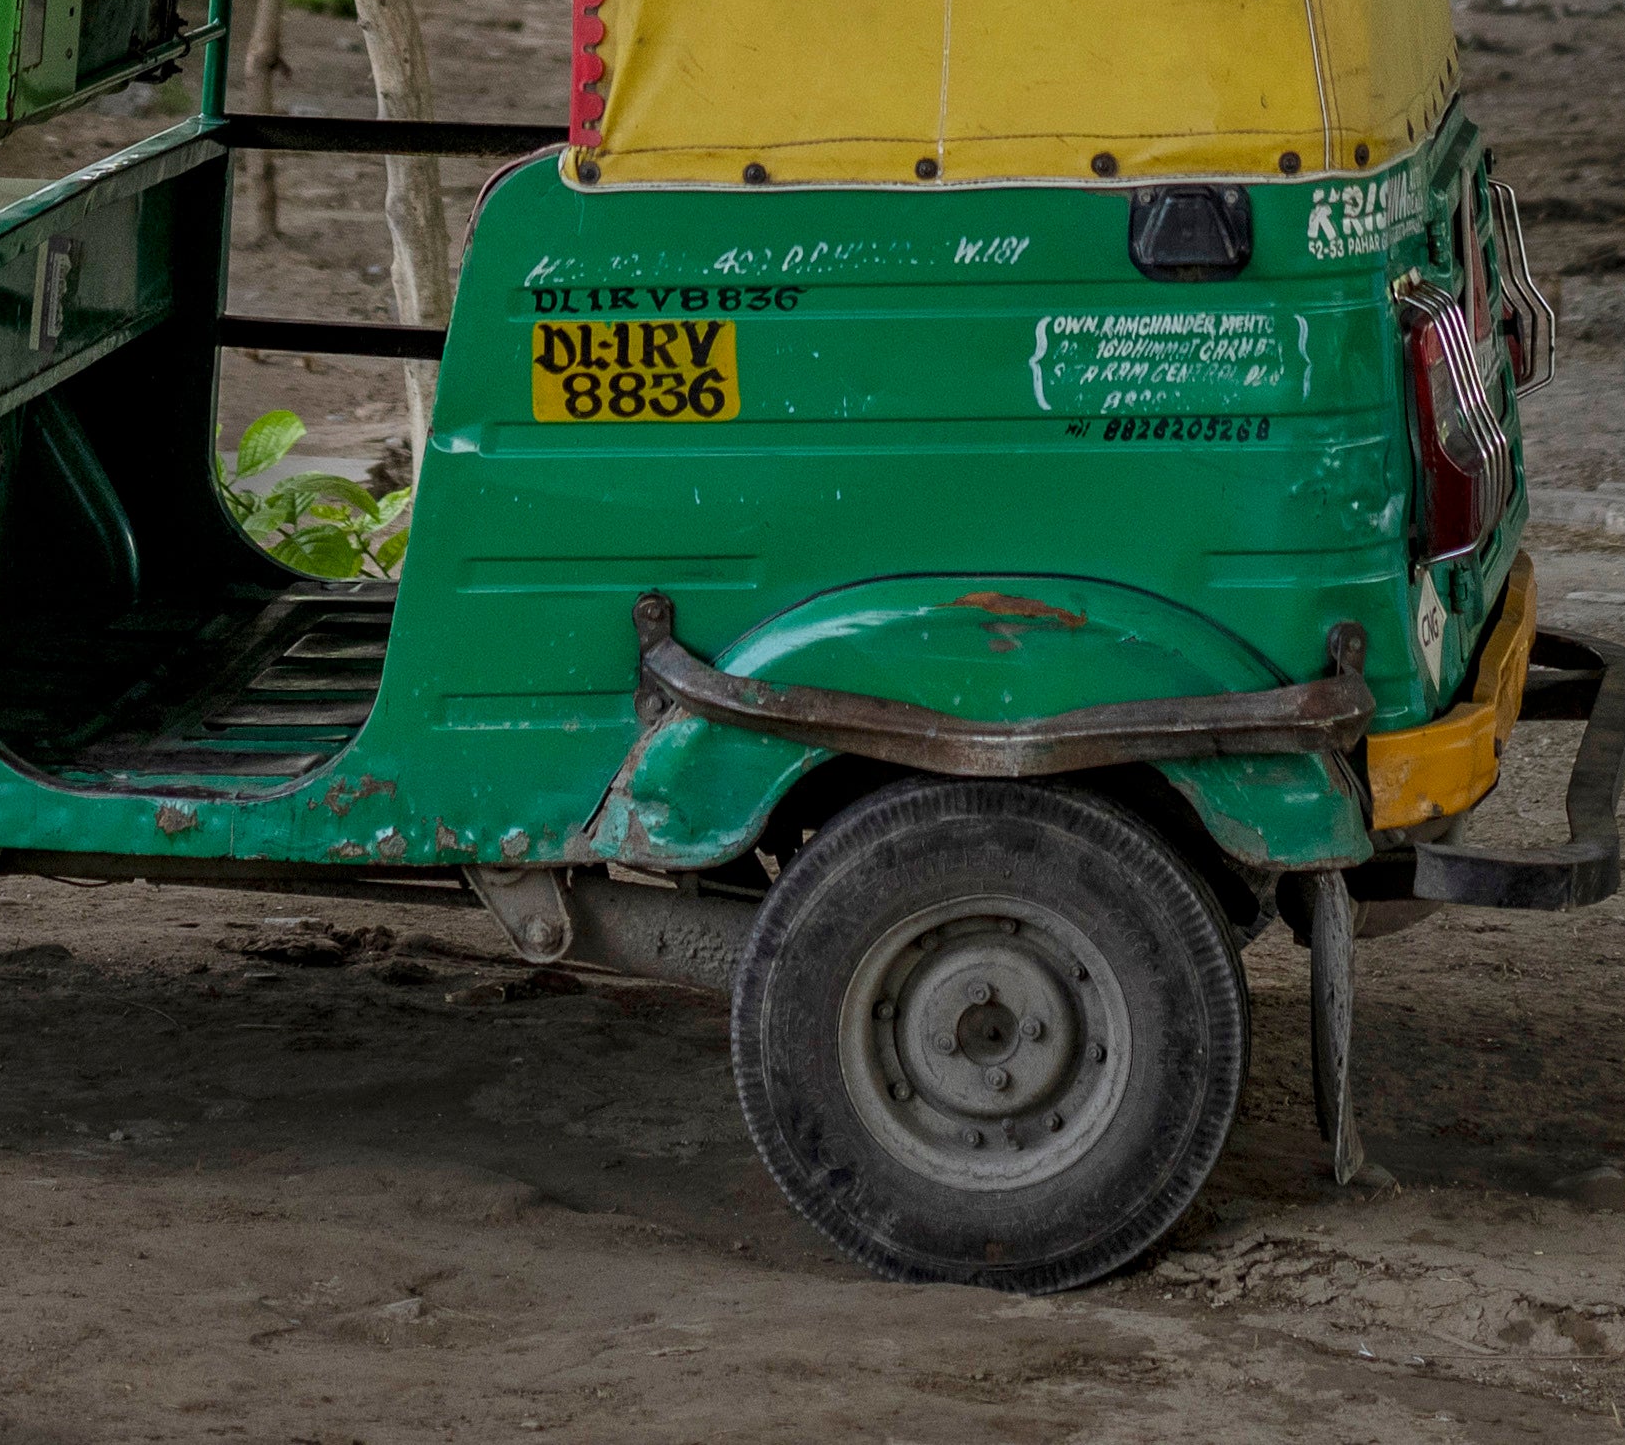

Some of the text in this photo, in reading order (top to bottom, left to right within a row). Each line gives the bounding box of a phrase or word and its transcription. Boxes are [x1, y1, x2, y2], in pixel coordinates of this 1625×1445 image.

[1348, 237, 1380, 256] PAHAR
[561, 367, 729, 419] 8836
[1421, 605, 1440, 648] CNG
